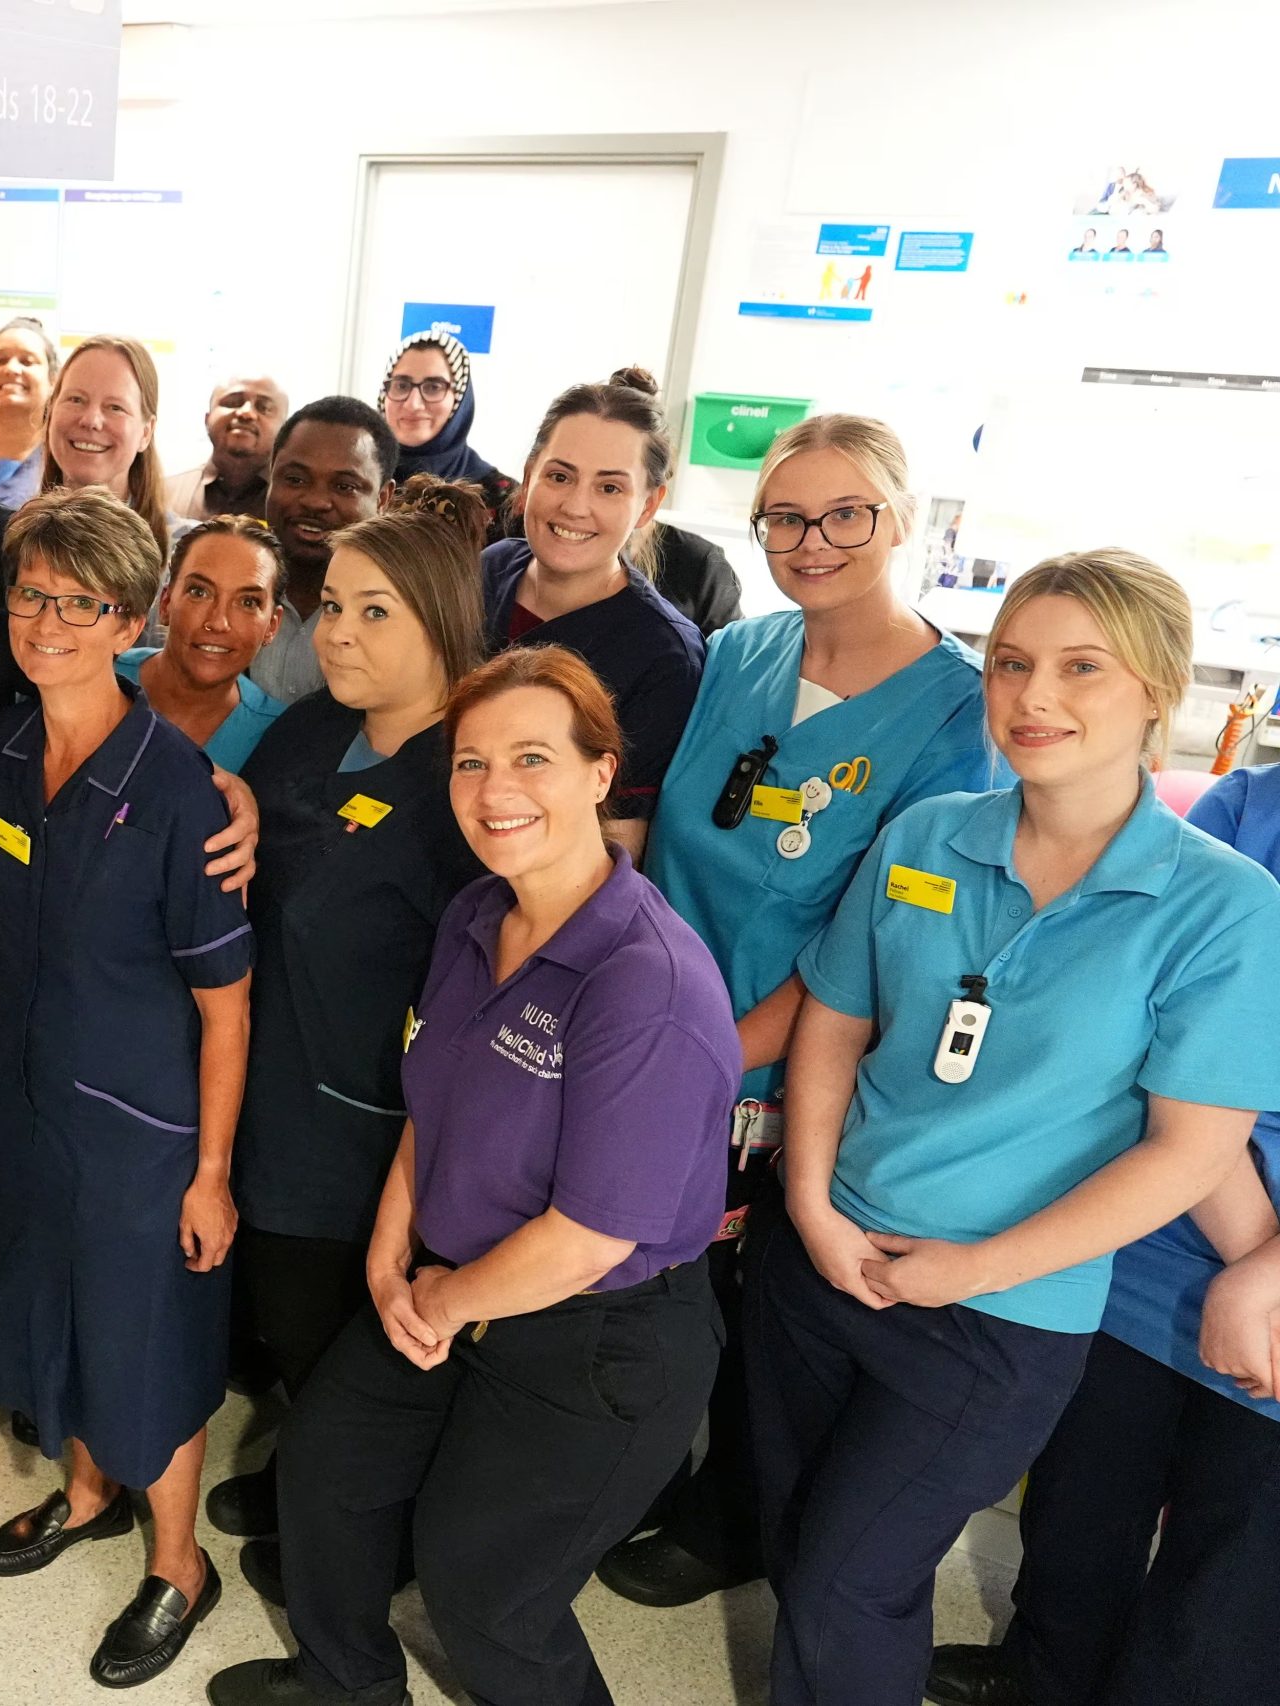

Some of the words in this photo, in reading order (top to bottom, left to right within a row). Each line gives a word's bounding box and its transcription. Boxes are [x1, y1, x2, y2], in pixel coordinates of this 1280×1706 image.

[30, 83, 94, 127] 18-22
[730, 404, 770, 418] clinell
[890, 882, 909, 891] Rachel
[497, 1023, 548, 1066] WellChild
